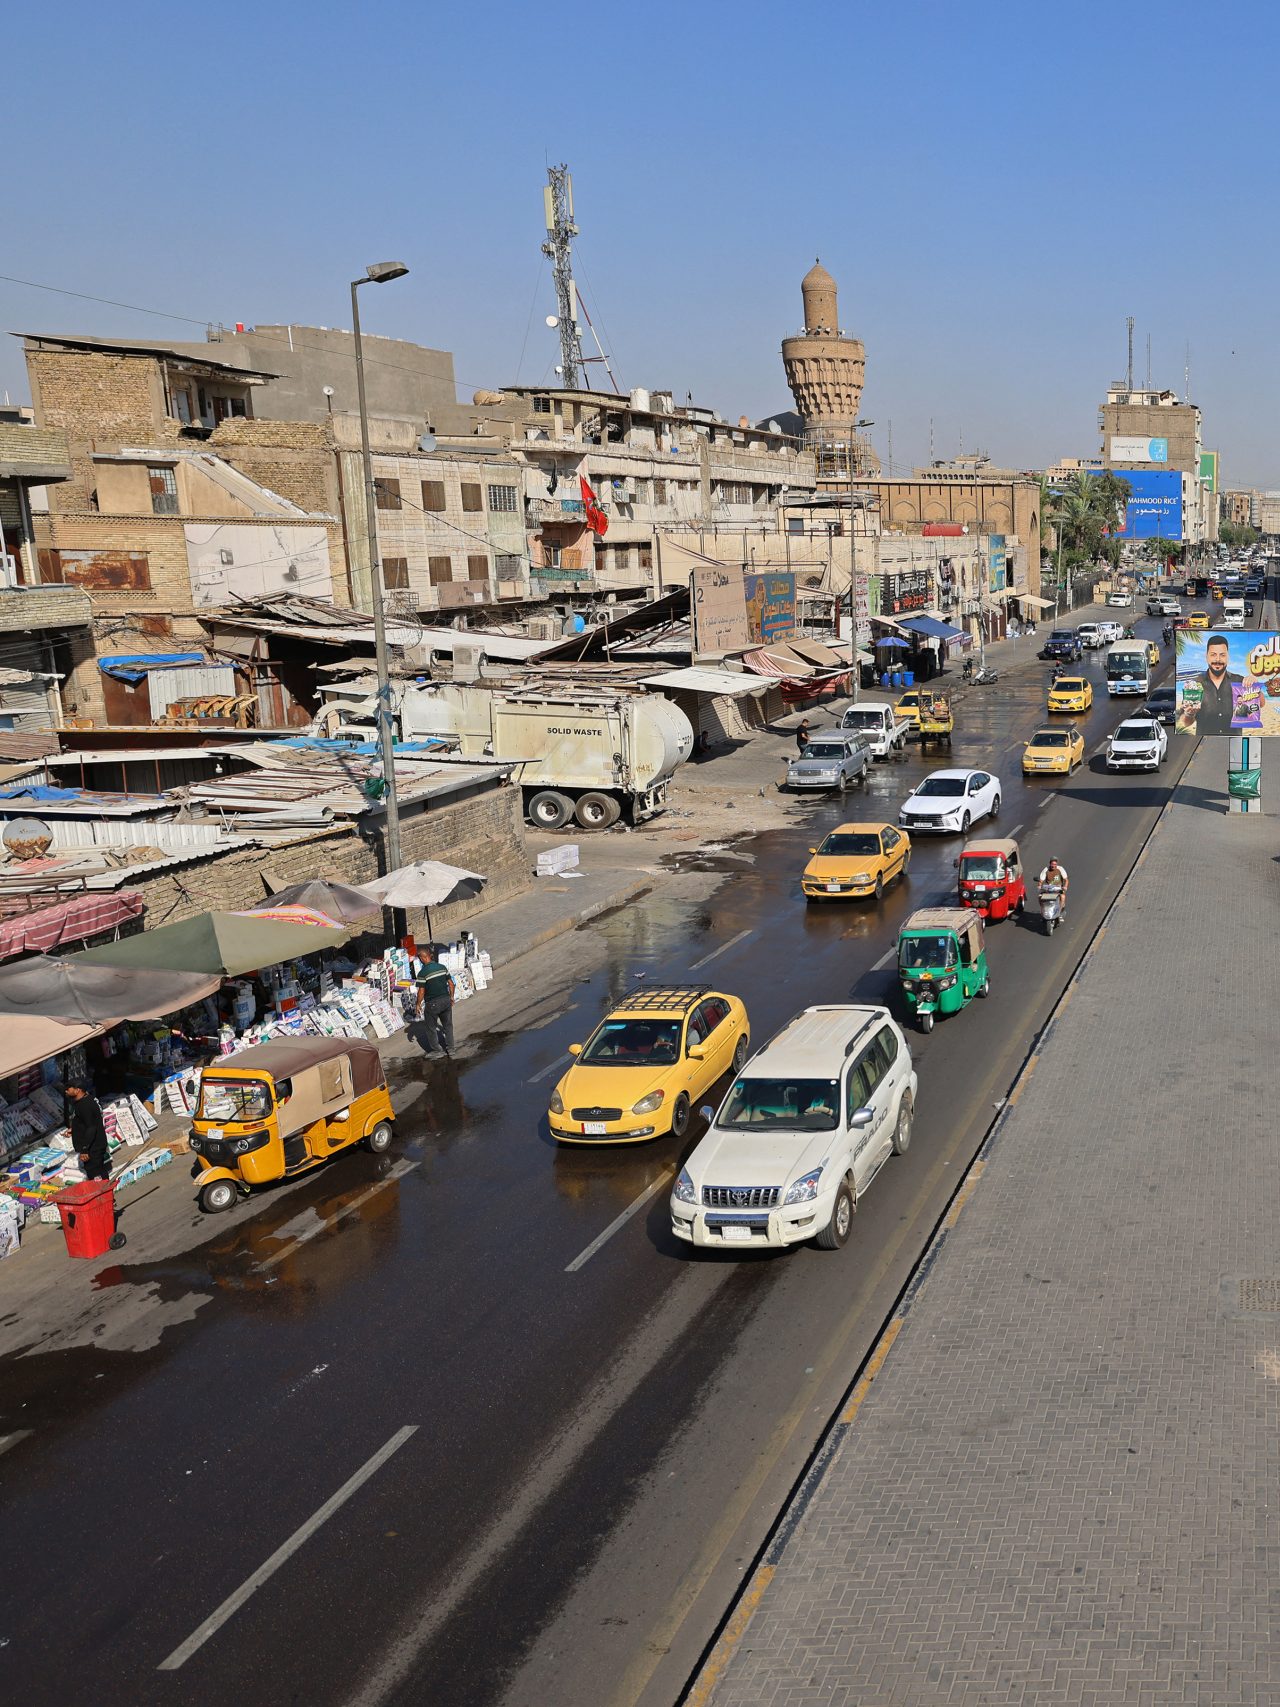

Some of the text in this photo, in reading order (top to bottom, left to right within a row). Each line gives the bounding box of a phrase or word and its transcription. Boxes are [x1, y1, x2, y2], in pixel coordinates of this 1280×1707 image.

[1128, 497, 1162, 505] MAHMOOD
[1136, 508, 1163, 516] محمود
[697, 588, 704, 603] 2
[547, 727, 603, 736] SOLID WASTE
[854, 1106, 888, 1162] PRADO
